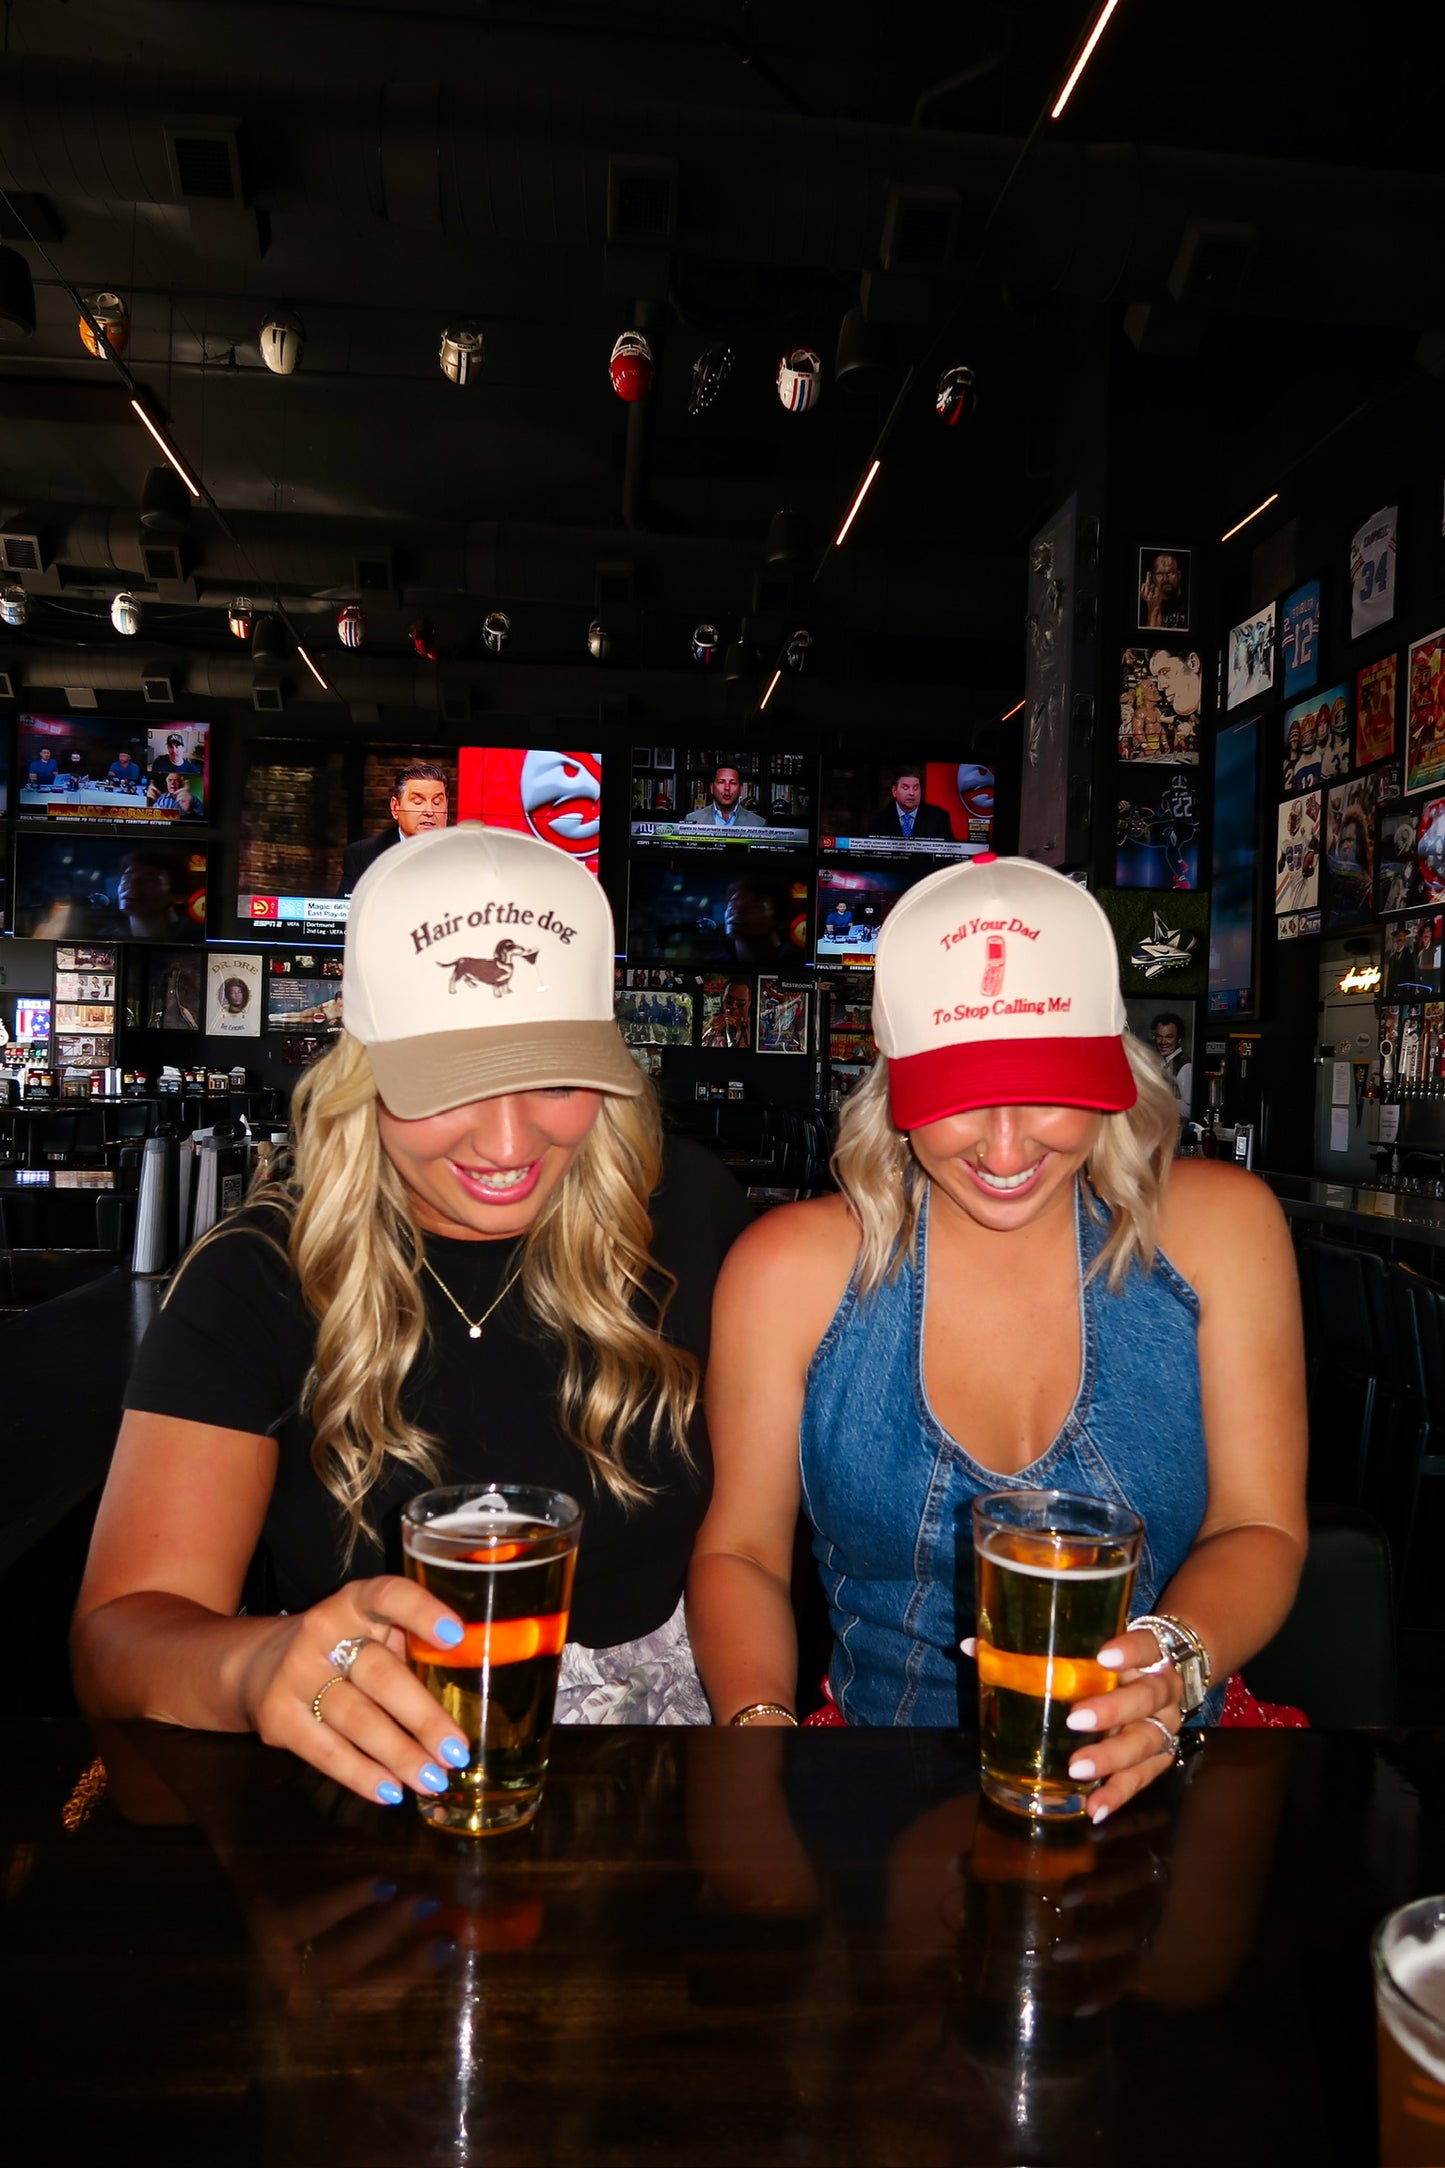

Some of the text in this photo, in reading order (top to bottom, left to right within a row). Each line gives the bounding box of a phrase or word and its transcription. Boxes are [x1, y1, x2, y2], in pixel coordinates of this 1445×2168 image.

[1359, 550, 1388, 602] 34
[1291, 617, 1313, 669] 12
[110, 806, 162, 818] CORNER
[1172, 797, 1193, 817] 22
[308, 903, 332, 911] Magic:
[411, 902, 578, 955] Hair of the dog
[940, 918, 1040, 951] Tell Your Dad
[234, 960, 259, 975] DRE
[782, 981, 814, 989] RESTROOMS
[932, 997, 1071, 1025] To Stop Calling Me!
